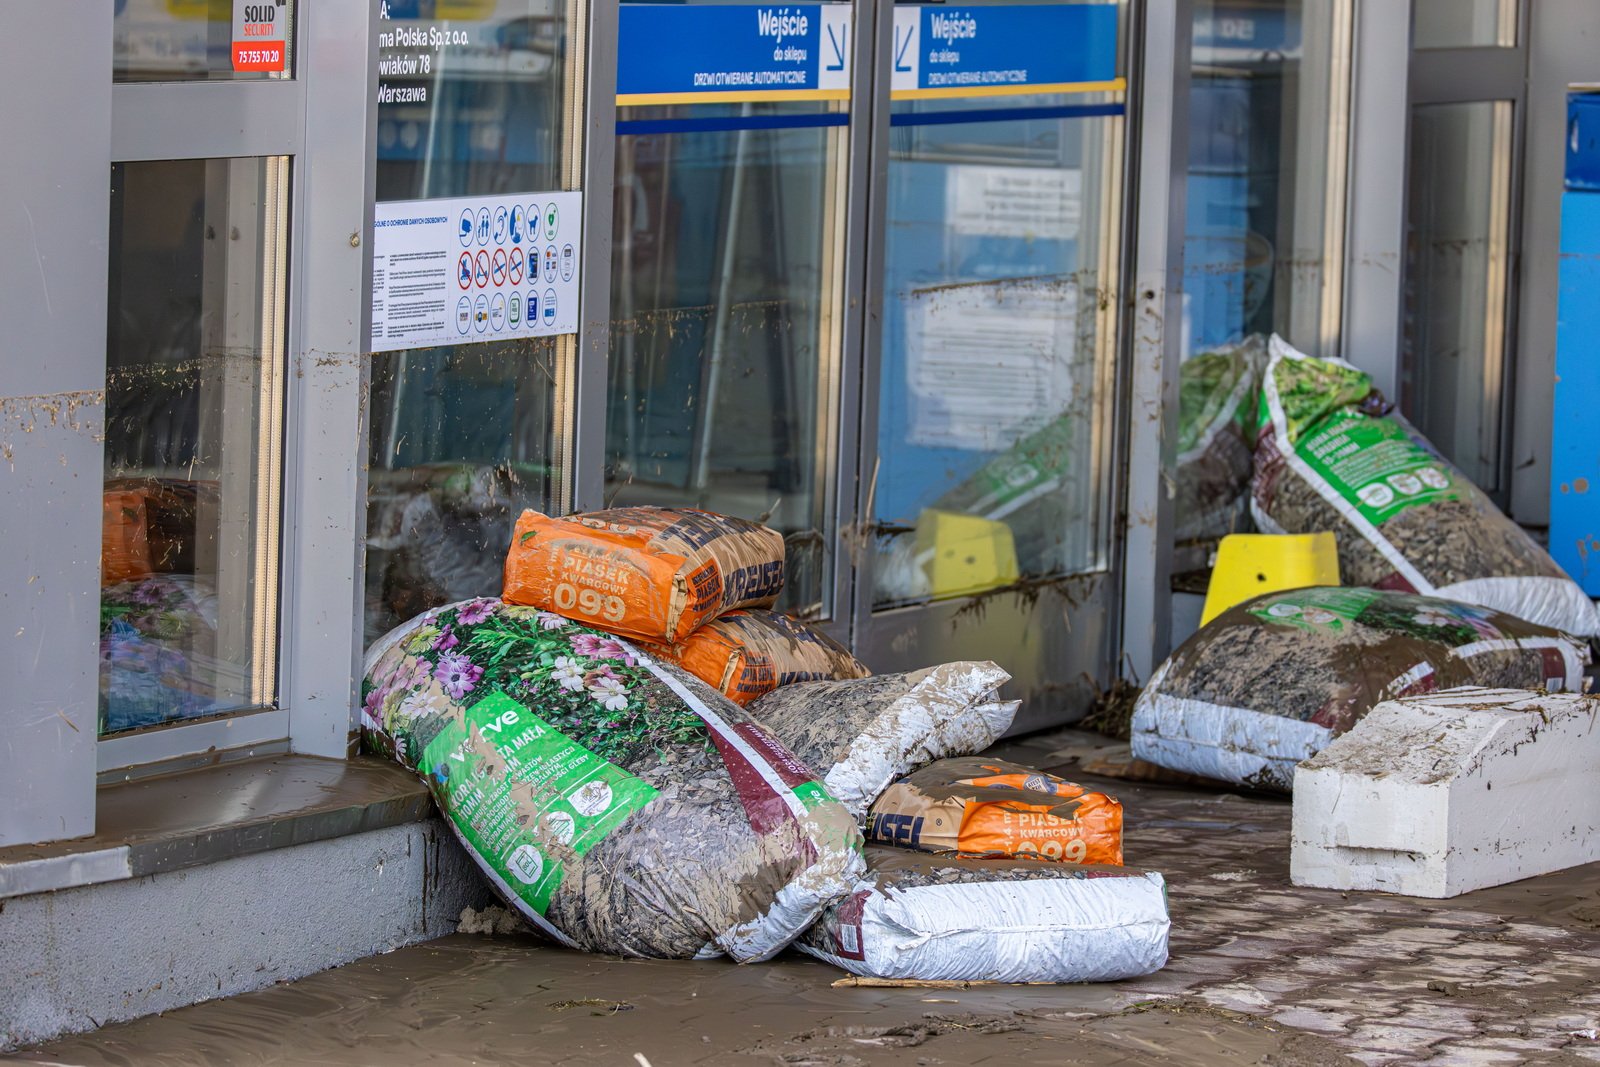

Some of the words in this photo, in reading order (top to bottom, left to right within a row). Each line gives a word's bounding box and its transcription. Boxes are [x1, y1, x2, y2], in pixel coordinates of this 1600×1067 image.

[244, 5, 275, 23] SOLID
[243, 23, 275, 37] SECURITY
[758, 8, 808, 44] Wejście
[931, 11, 976, 46] Wejście
[396, 27, 428, 47] Polska
[429, 26, 444, 51] Sp.
[445, 31, 451, 46] z
[452, 30, 469, 46] o.o.
[239, 50, 248, 63] 75
[248, 50, 260, 63] 755
[261, 50, 270, 63] 70
[270, 50, 280, 63] 20
[419, 54, 431, 75] 78
[773, 46, 783, 61] do
[784, 45, 808, 65] sklepu
[929, 49, 938, 63] do
[938, 48, 960, 66] sklepu
[693, 72, 716, 86] DRZWI
[716, 71, 754, 86] OTWIERANE
[754, 70, 807, 85] AUTOMATYCZNIE
[928, 73, 947, 85] DRZWI
[947, 71, 981, 84] OTWIERANE
[981, 70, 1028, 83] AUTOMATYCZNIE
[561, 556, 631, 585] PIASEK
[561, 571, 628, 596] KWARCOWY
[696, 575, 721, 600] PIASEK
[554, 582, 627, 622] 099
[450, 777, 476, 807] KORA
[471, 744, 515, 782] IGTA
[512, 724, 547, 751] MAŁA
[567, 754, 589, 770] GLEBY
[486, 781, 509, 805] WZROST
[1019, 826, 1084, 839] KWARCOWY
